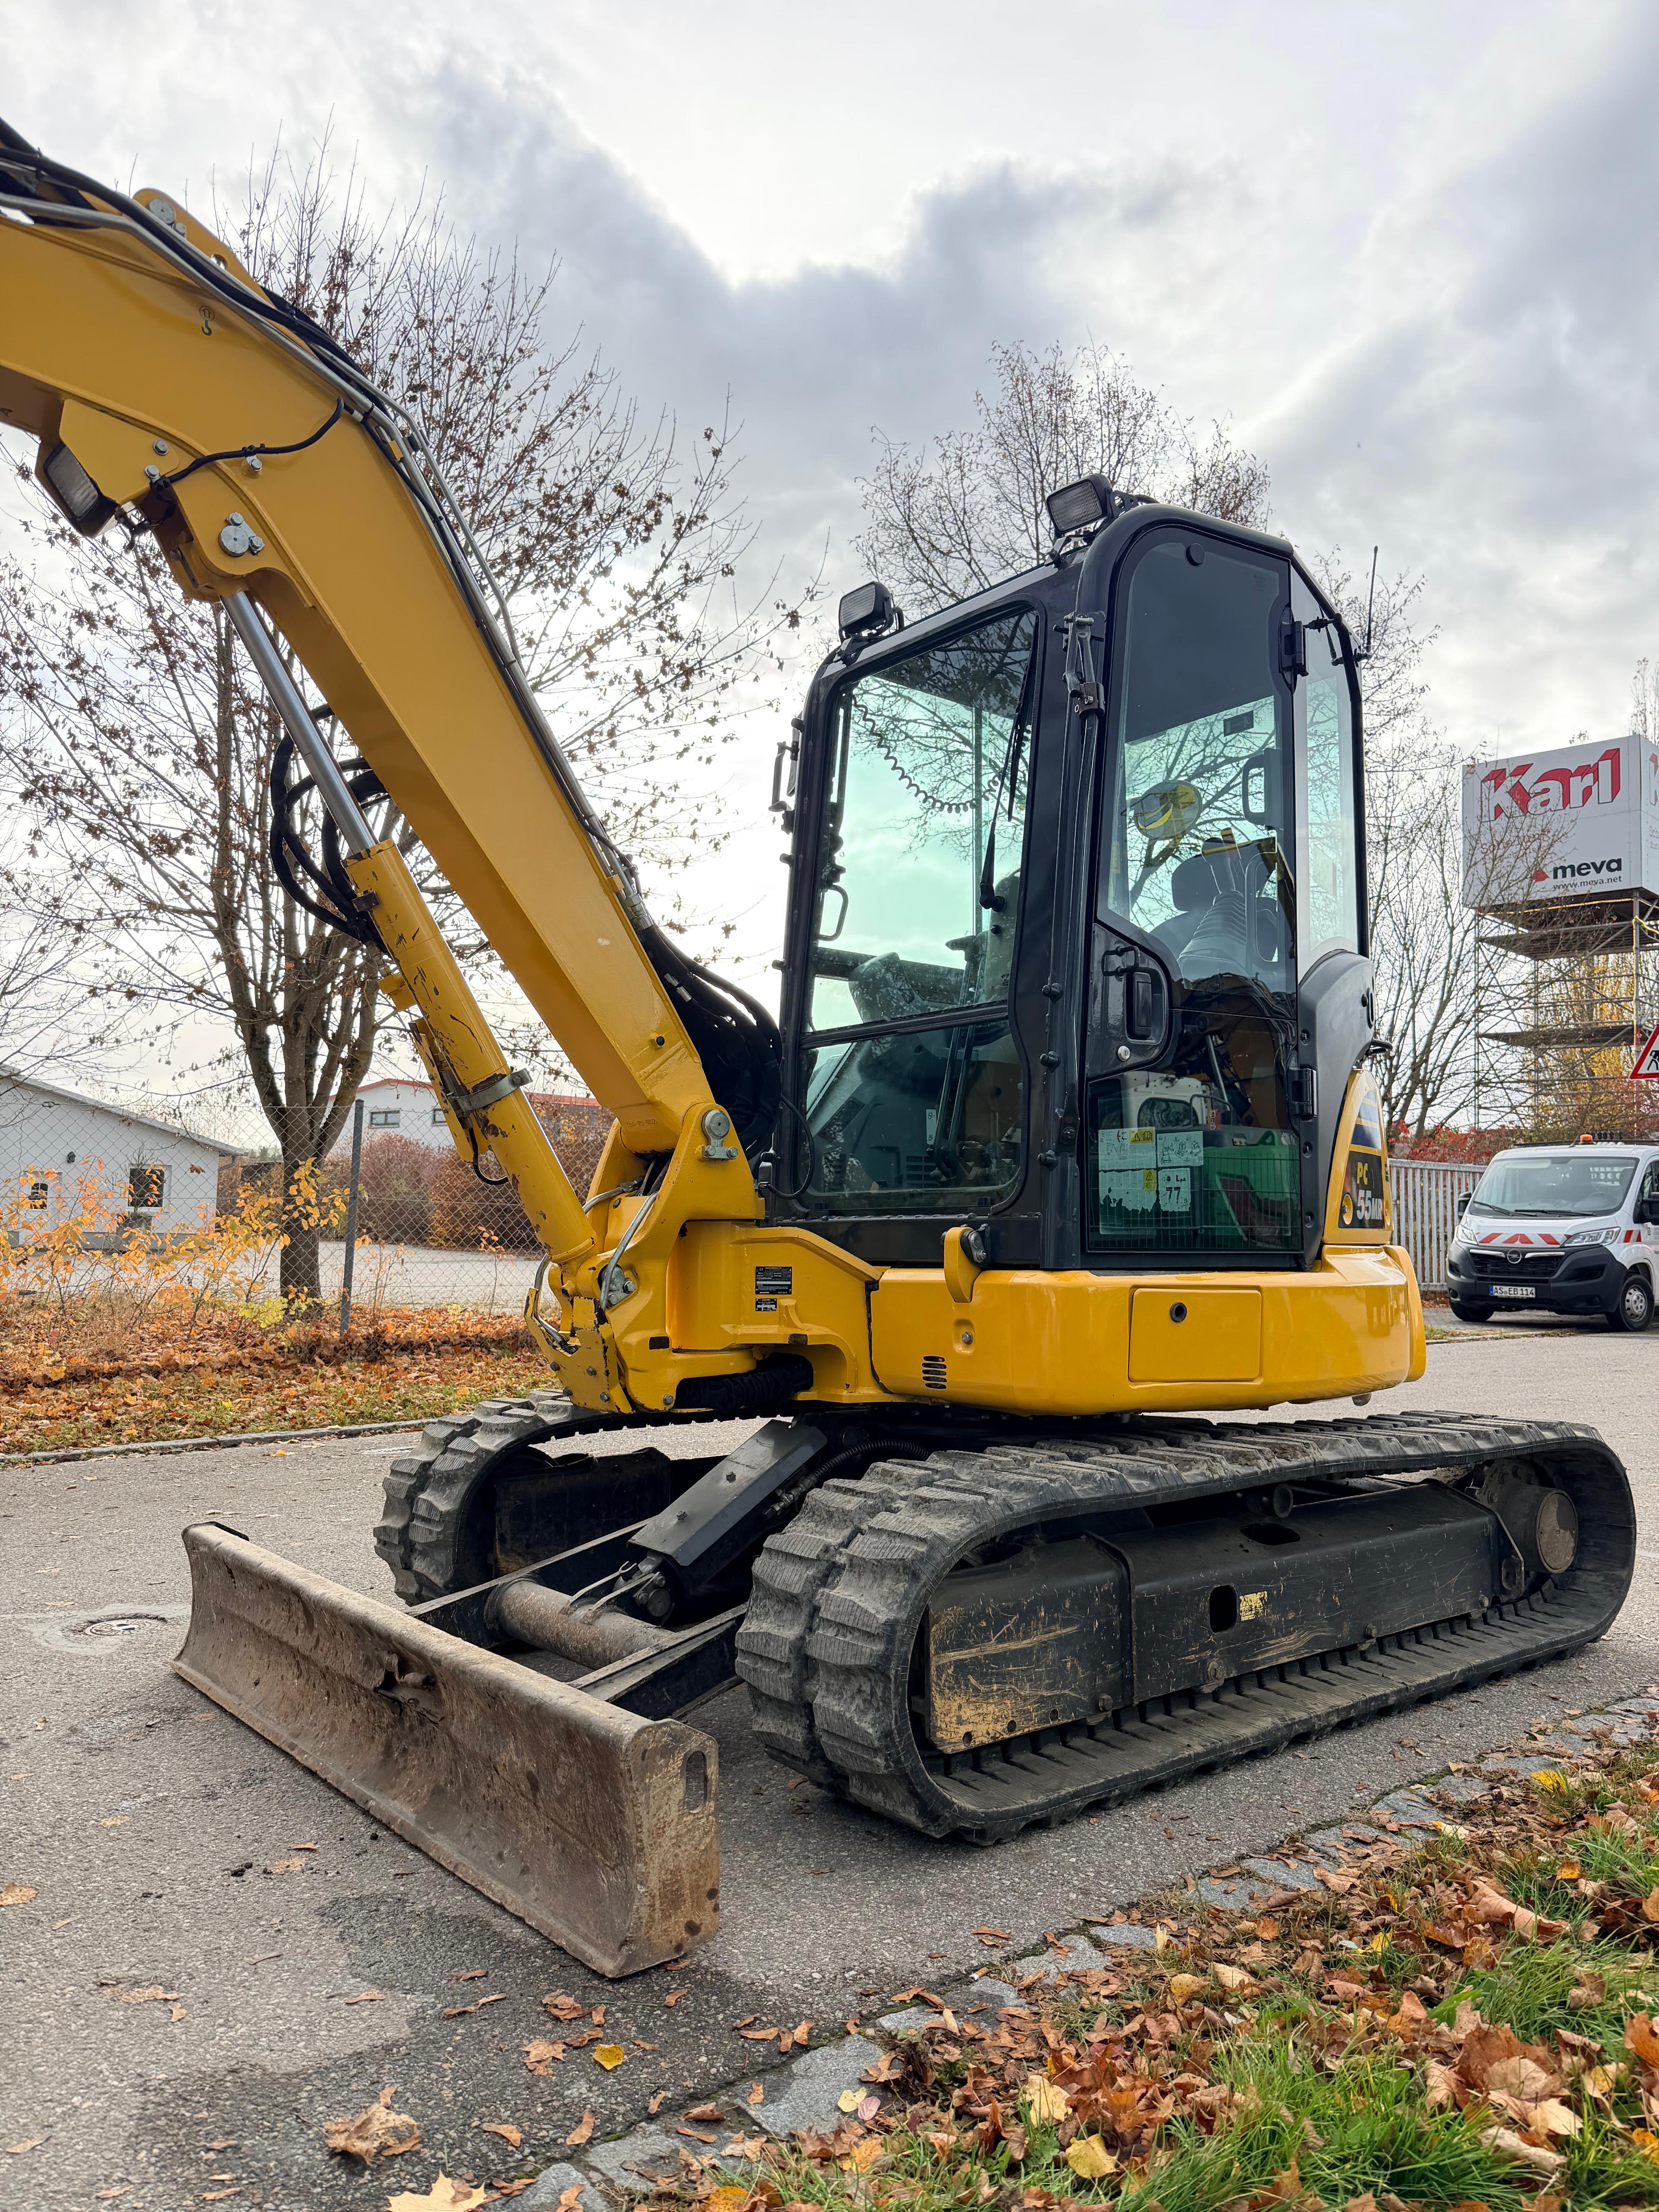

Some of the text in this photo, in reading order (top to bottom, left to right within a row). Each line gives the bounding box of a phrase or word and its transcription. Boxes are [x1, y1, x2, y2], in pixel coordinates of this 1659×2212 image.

[1481, 747, 1621, 823] Karl
[1553, 858, 1622, 880] meva
[1553, 875, 1622, 890] www.meva.net
[1357, 1162, 1368, 1185] PC
[1166, 1186, 1181, 1204] 77
[1356, 1189, 1382, 1220] 55MR
